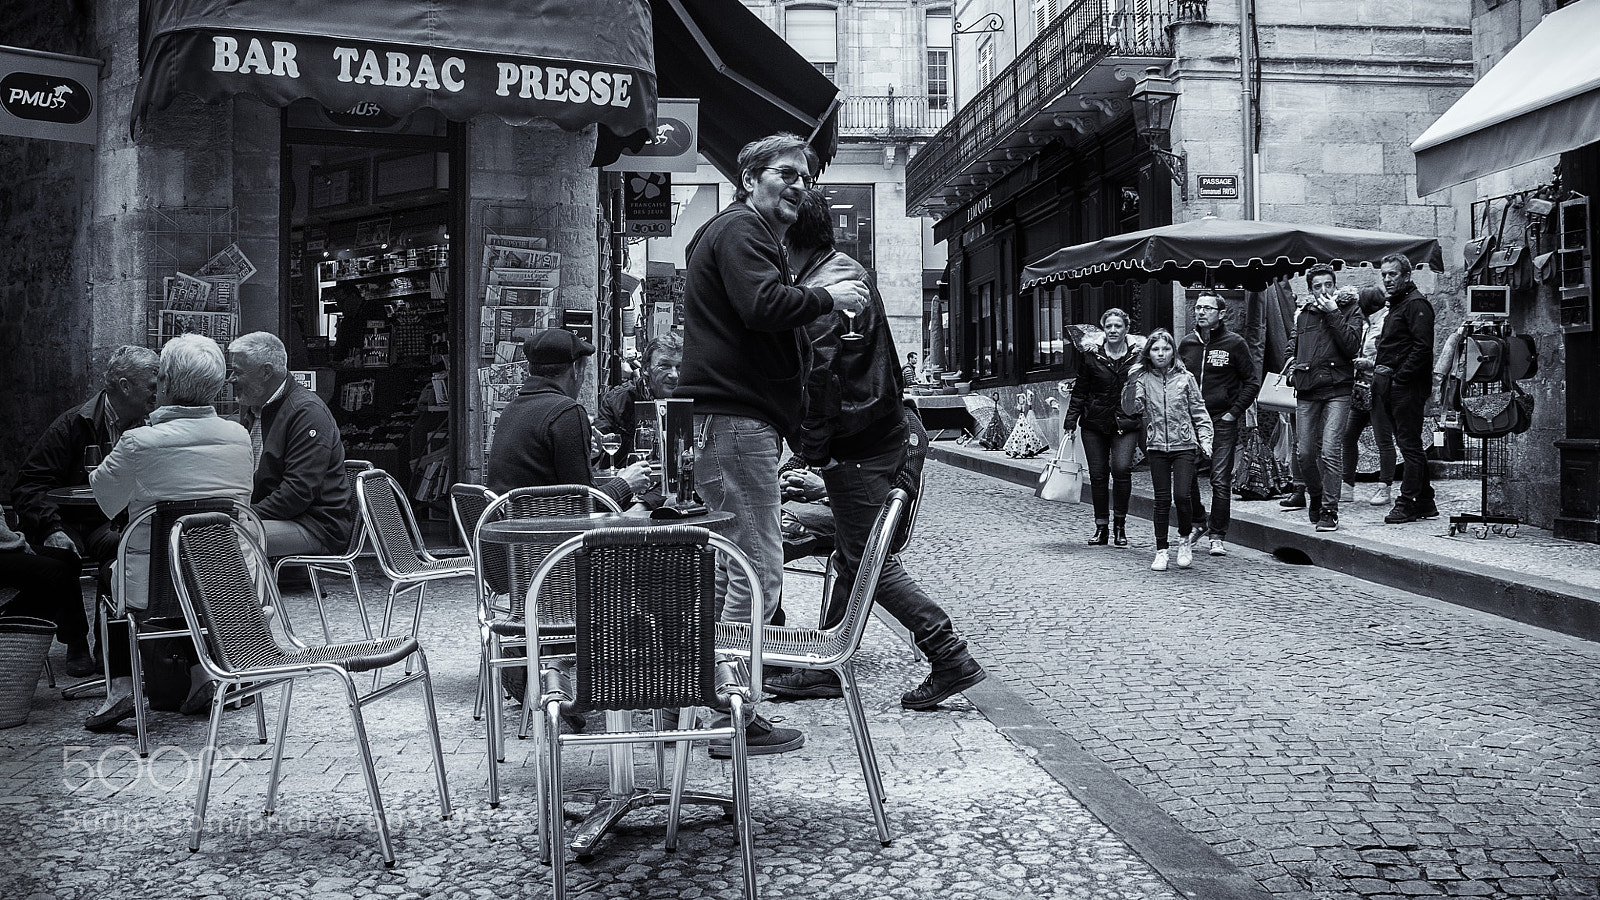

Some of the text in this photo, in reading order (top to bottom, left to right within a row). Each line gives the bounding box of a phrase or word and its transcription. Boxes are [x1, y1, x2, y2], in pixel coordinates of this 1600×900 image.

[212, 36, 633, 108] BAR TABAC PRESSE
[9, 87, 52, 108] PMU
[1200, 187, 1221, 195] Emmanuel
[631, 222, 666, 233] LOTO
